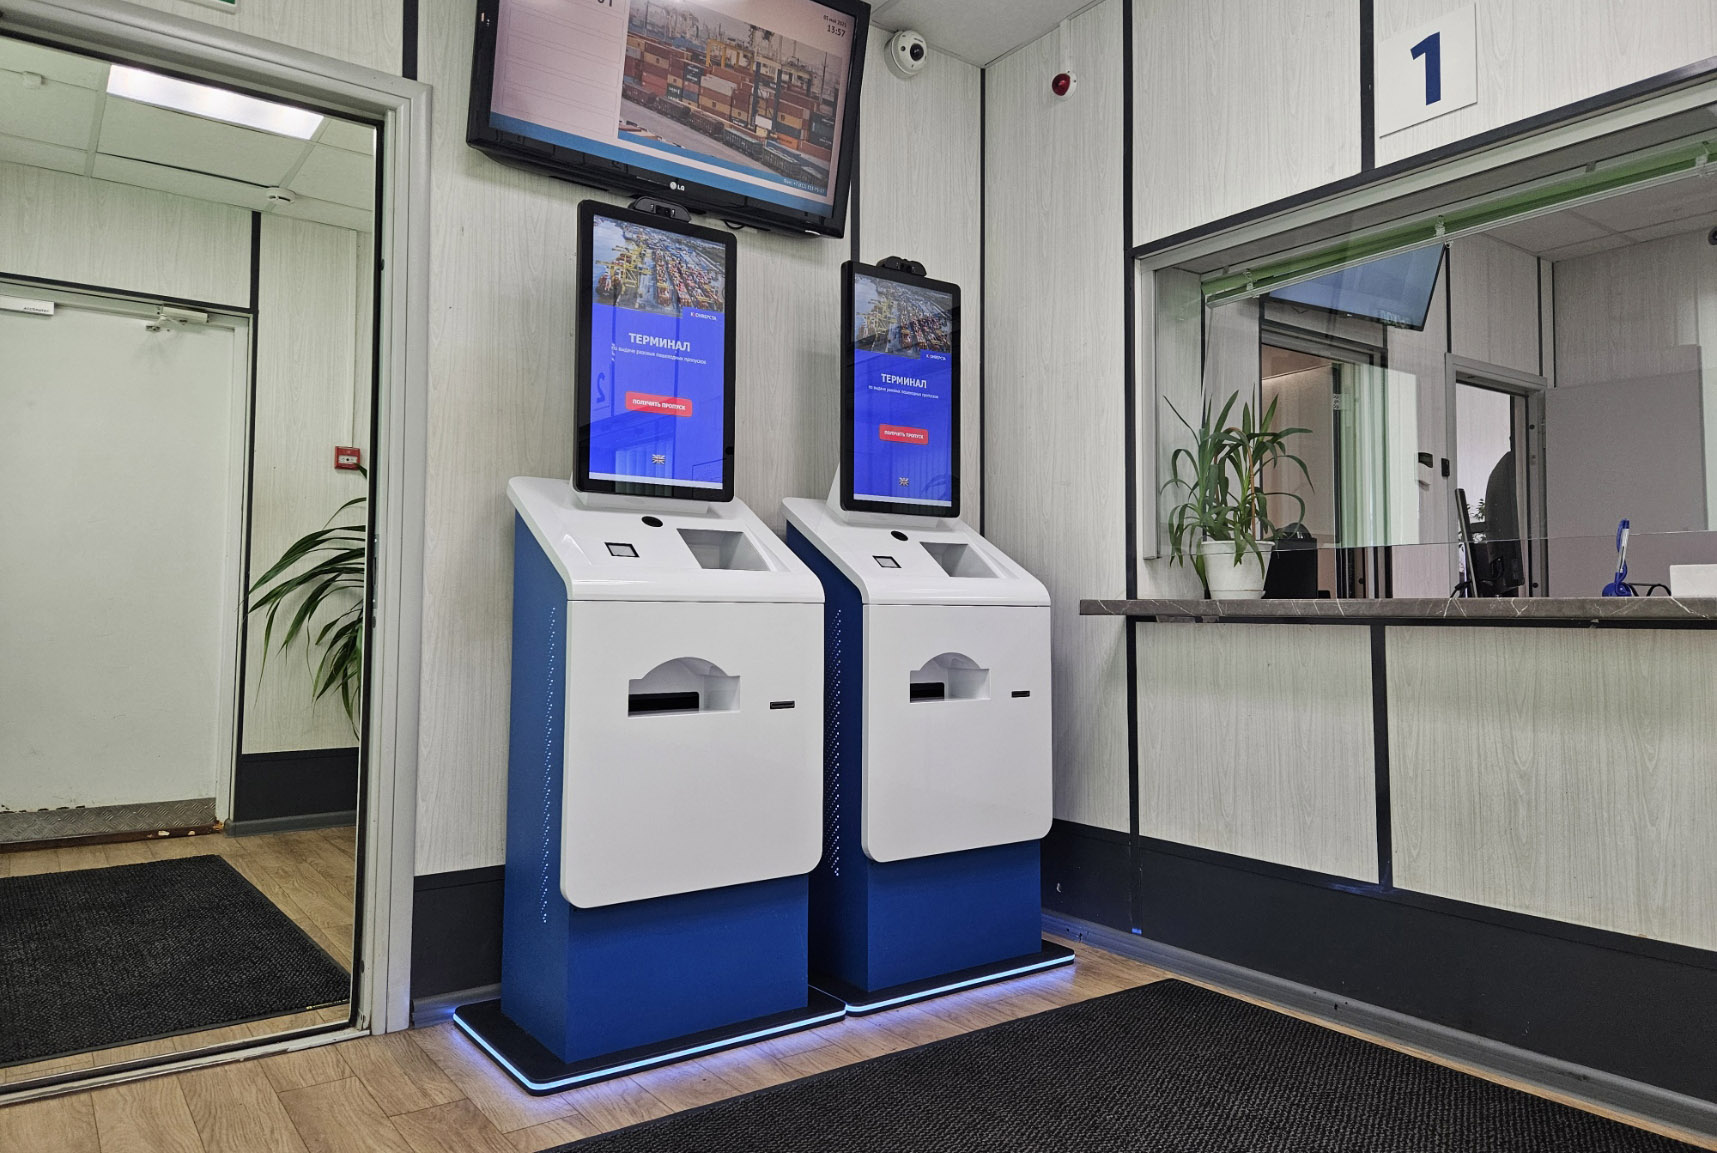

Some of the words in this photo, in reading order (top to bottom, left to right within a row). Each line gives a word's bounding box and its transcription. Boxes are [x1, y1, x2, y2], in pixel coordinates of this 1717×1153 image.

[827, 25, 846, 37] 13:57
[1410, 31, 1441, 106] 1
[628, 333, 691, 352] ТЕРМИНАЛ
[880, 373, 927, 389] ТЕРМИНАЛ
[661, 402, 686, 411] ПРОПУСК
